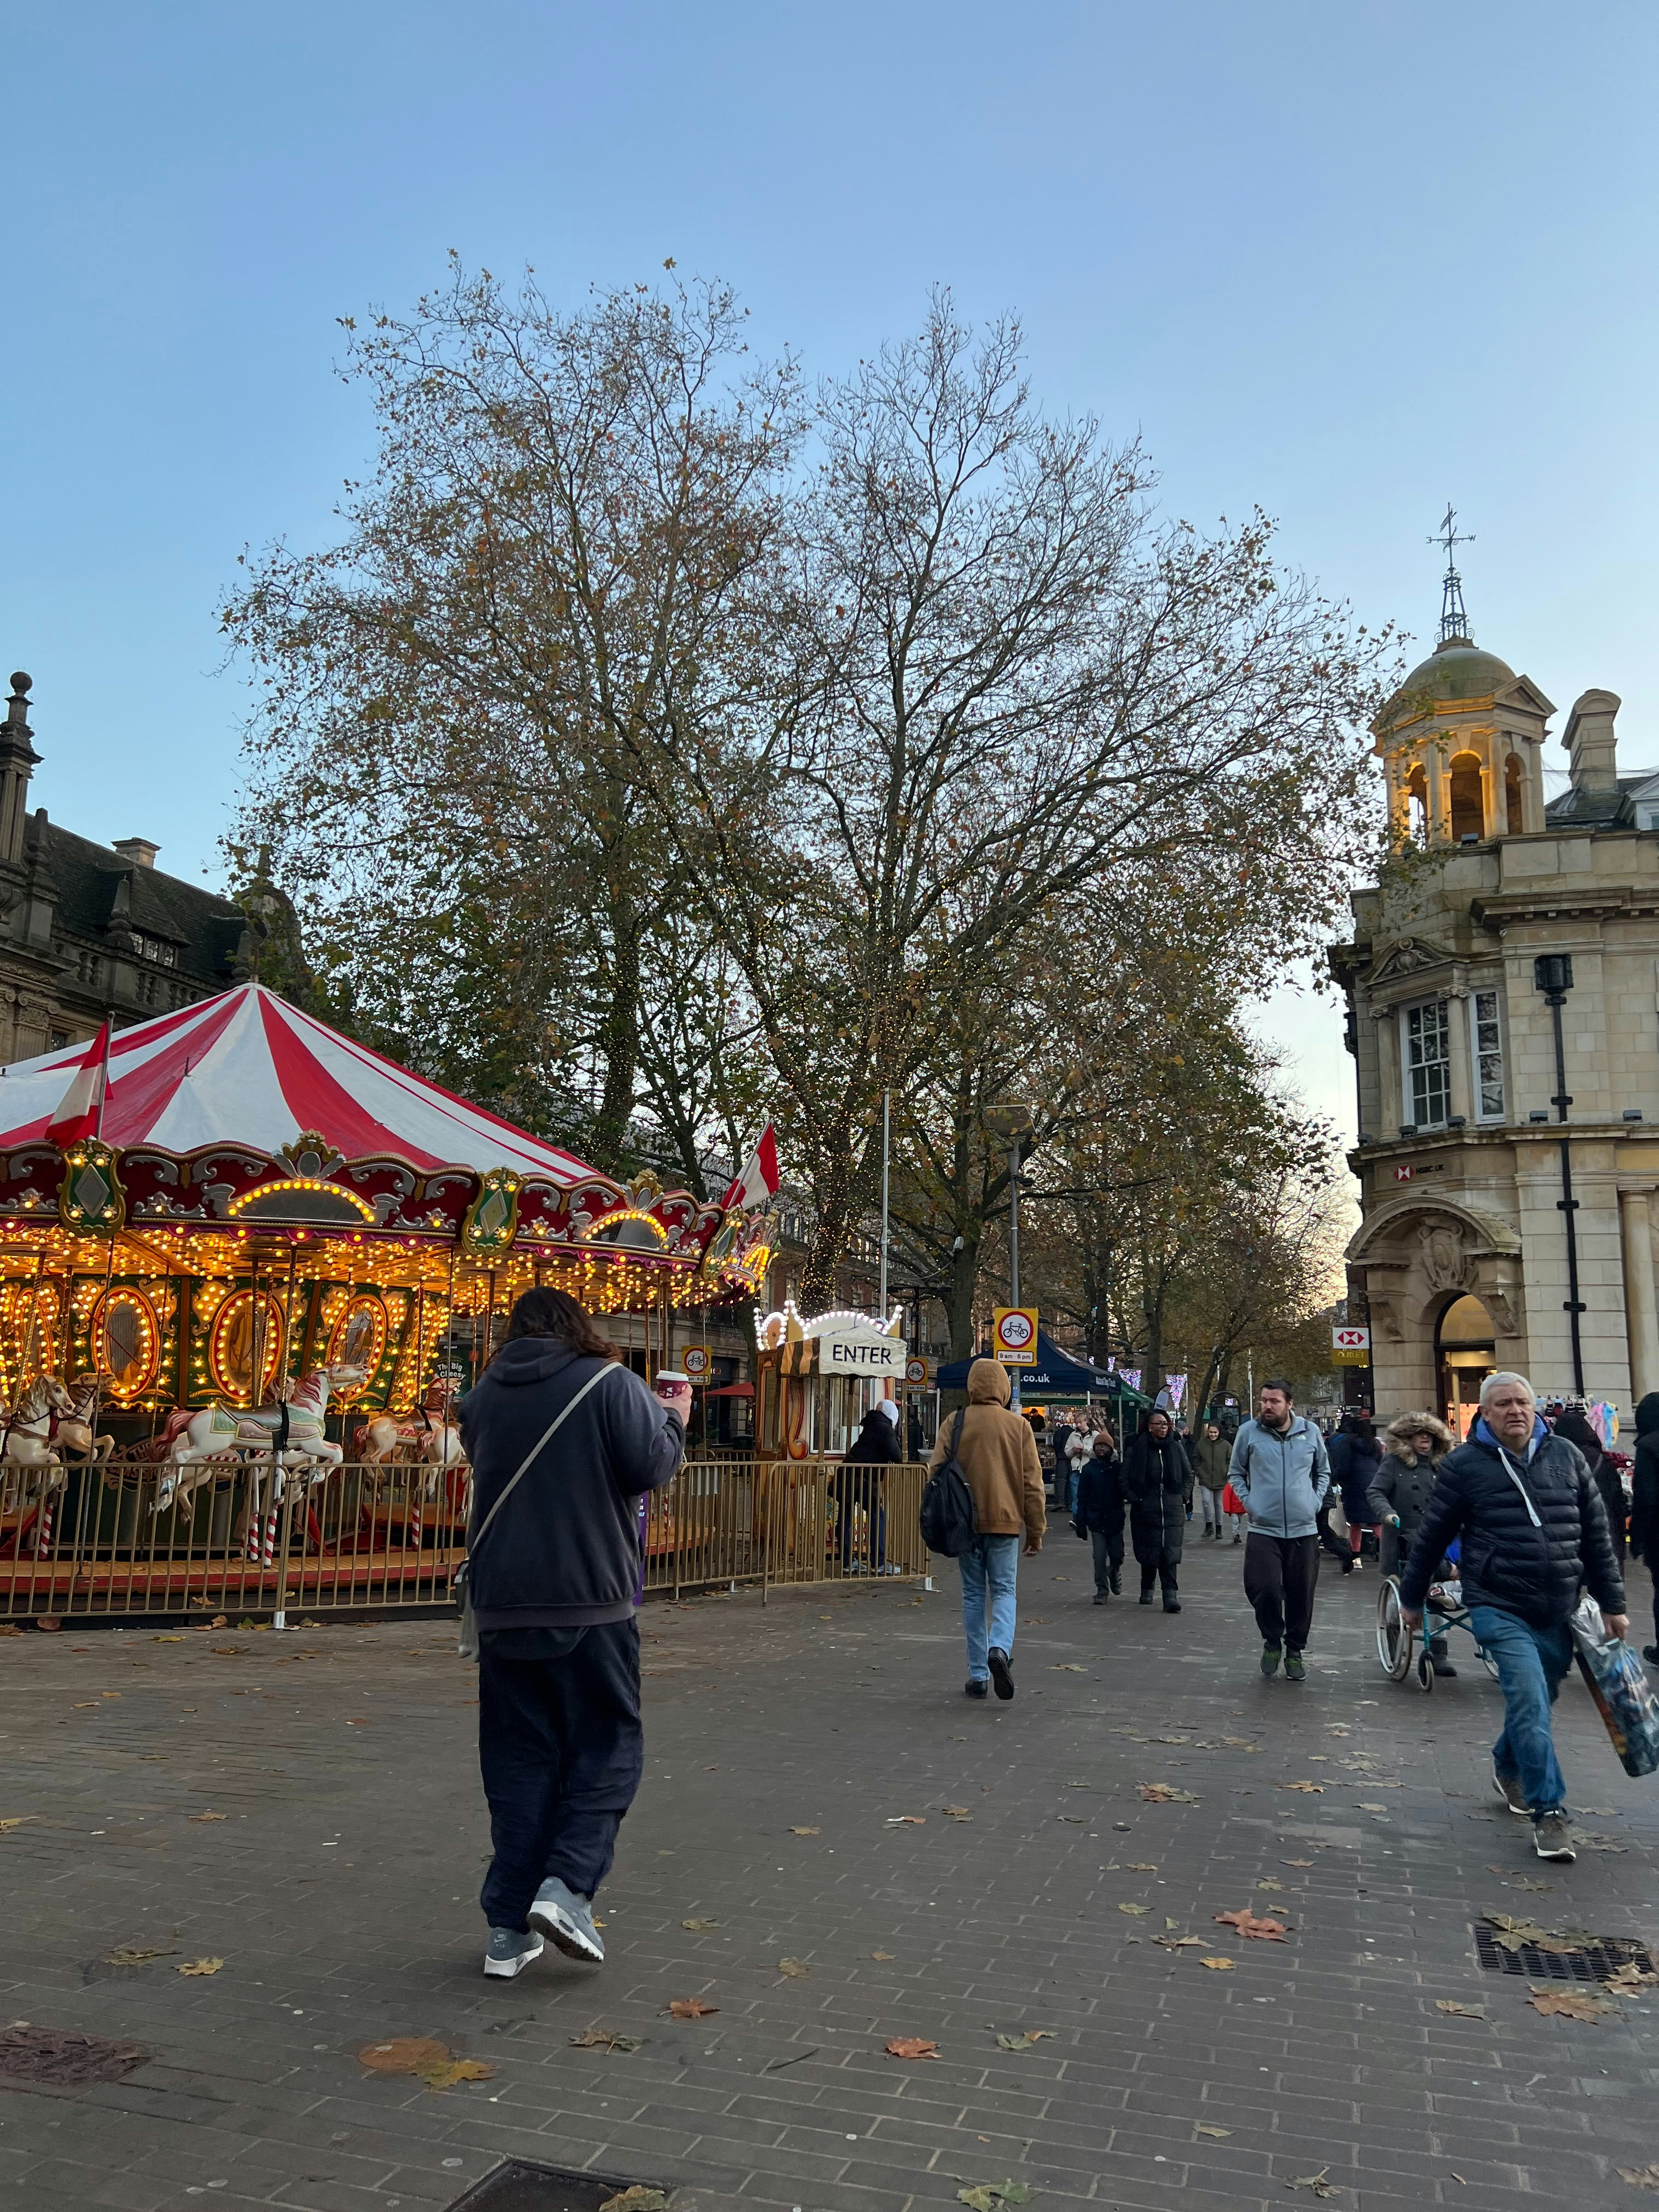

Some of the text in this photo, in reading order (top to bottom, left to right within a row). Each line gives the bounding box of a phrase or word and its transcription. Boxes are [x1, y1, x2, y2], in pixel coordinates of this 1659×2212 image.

[1415, 1166, 1434, 1174] HSBC
[833, 1344, 892, 1364] ENTER
[451, 1362, 462, 1372] Big
[1008, 1373, 1050, 1383] .co.uk
